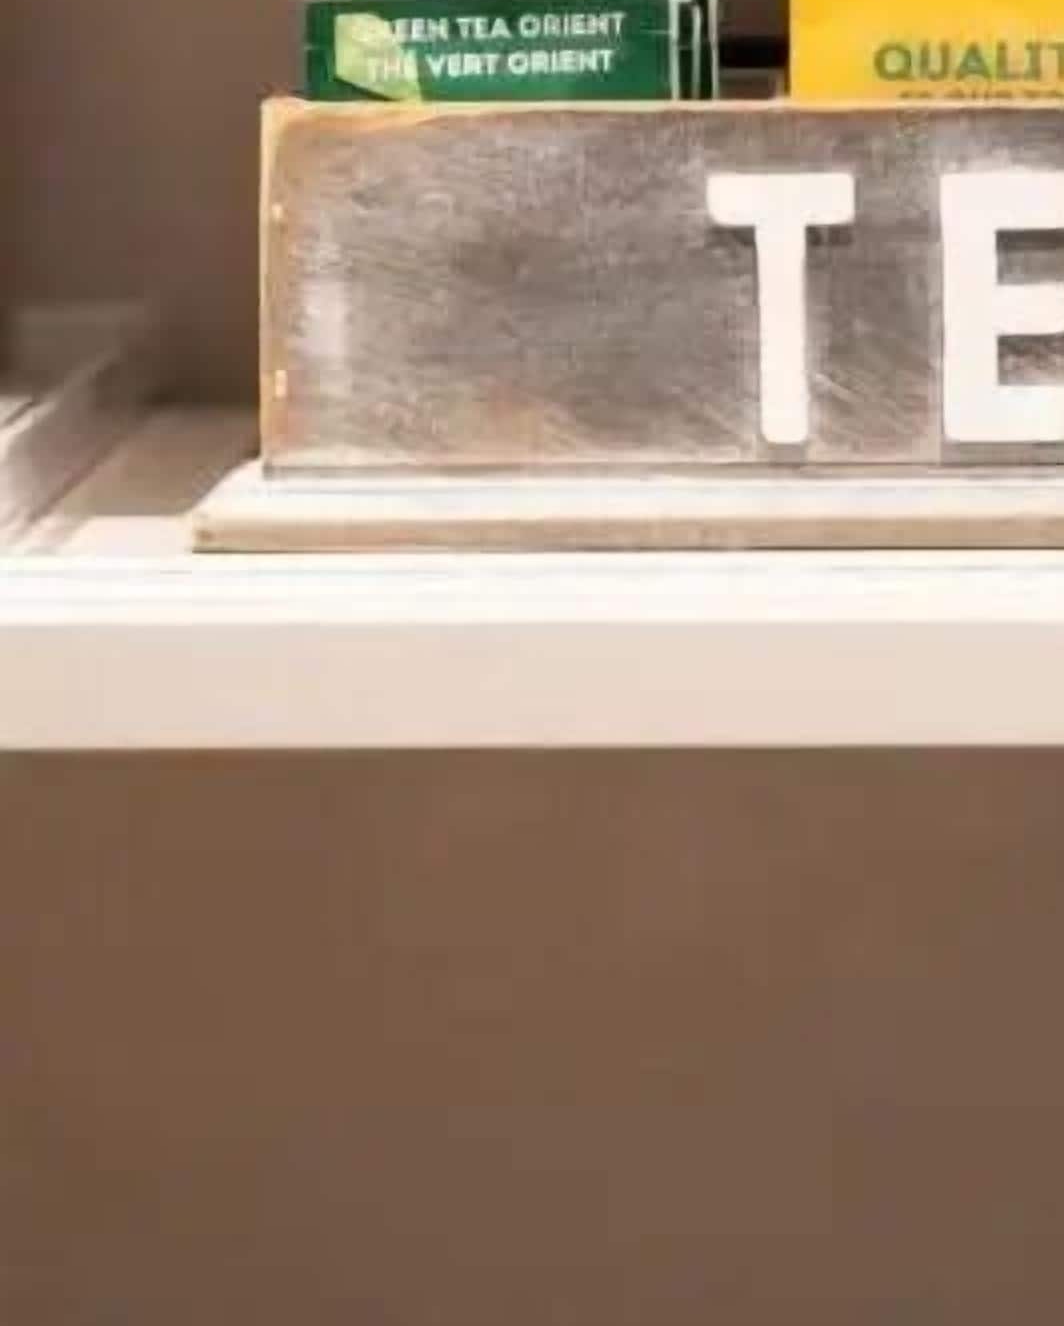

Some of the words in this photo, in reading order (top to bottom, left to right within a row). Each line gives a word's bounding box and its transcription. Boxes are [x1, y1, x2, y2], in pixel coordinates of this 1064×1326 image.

[351, 19, 449, 44] EEN
[456, 16, 513, 40] TEA
[519, 11, 627, 38] ORIENT
[424, 53, 500, 78] VERT
[507, 49, 615, 75] ORIENT
